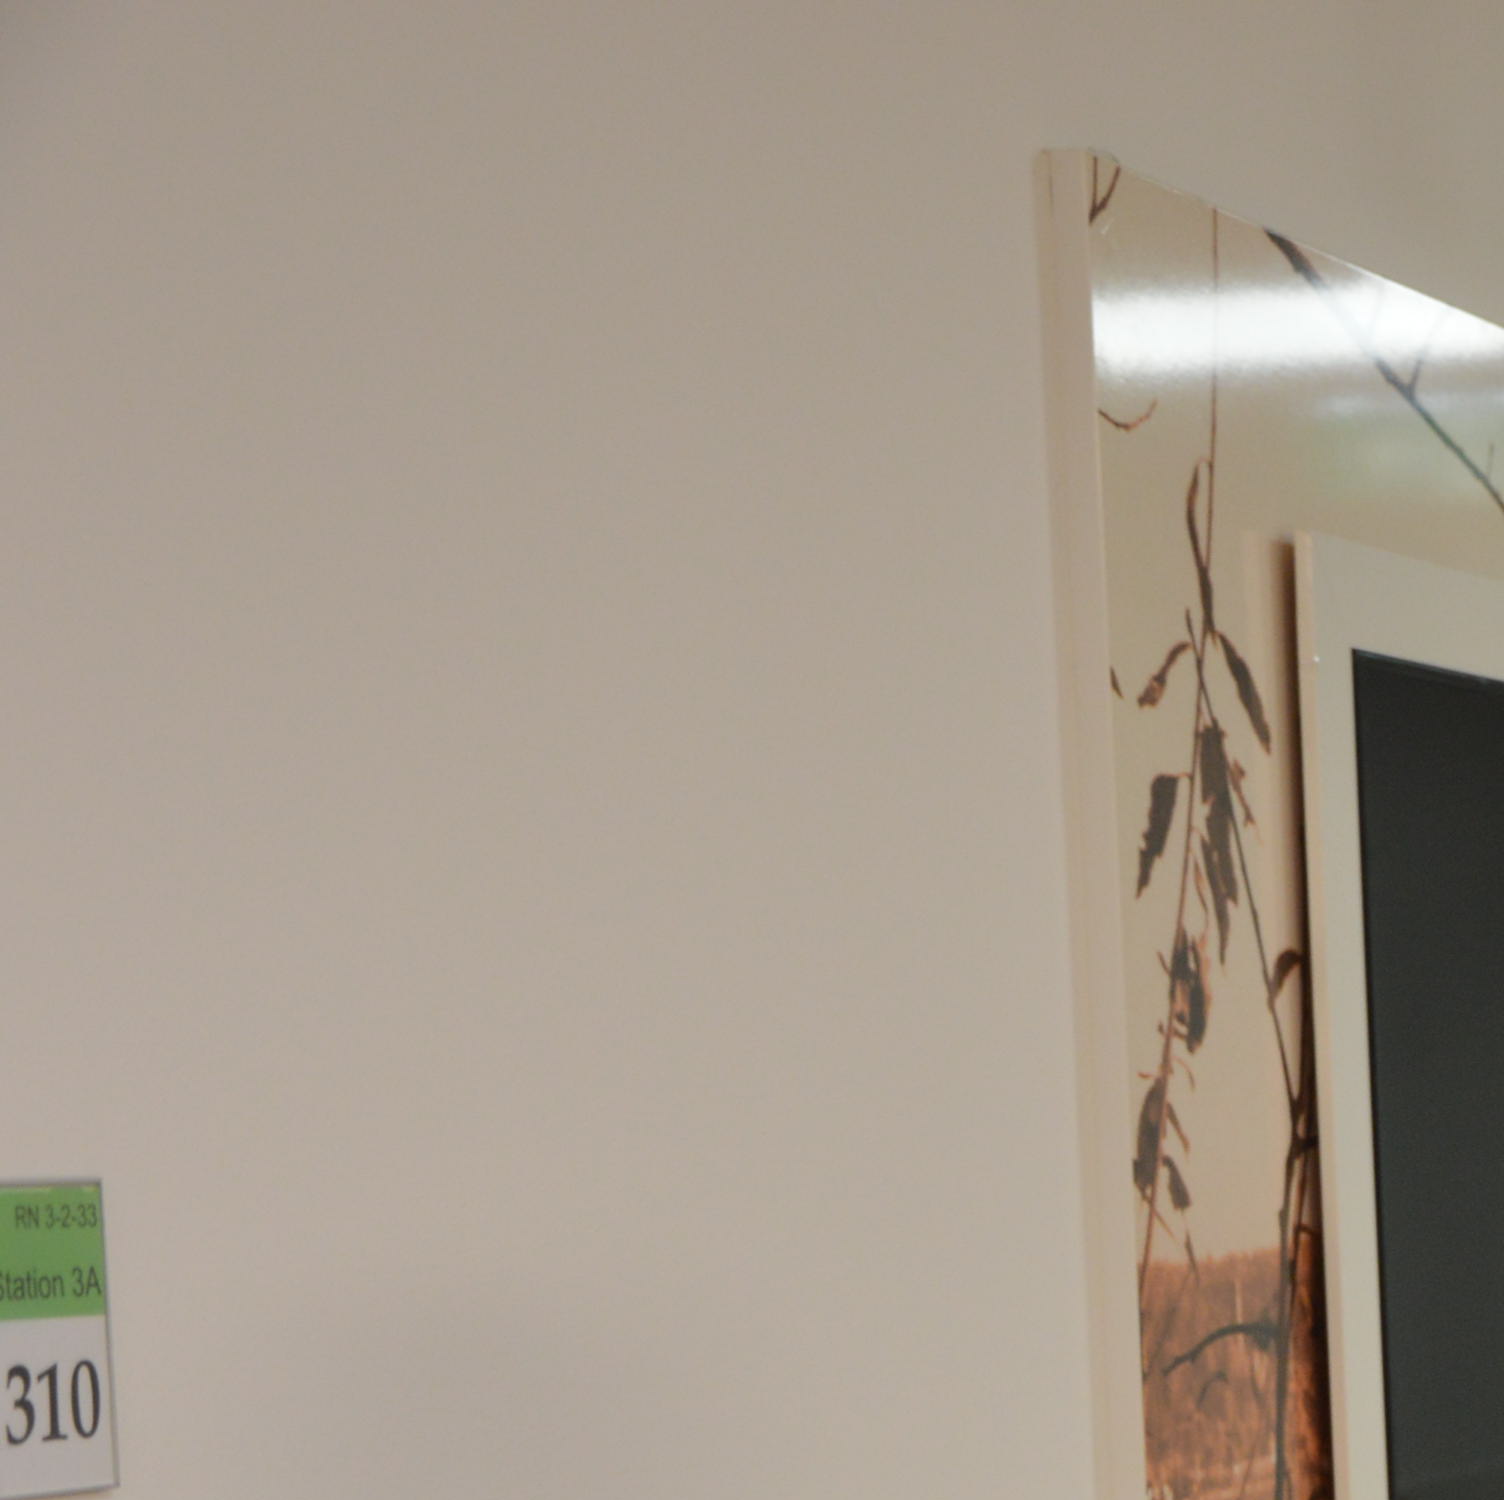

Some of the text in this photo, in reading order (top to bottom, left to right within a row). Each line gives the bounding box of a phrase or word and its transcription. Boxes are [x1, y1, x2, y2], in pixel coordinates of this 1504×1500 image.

[15, 1204, 98, 1230] RN 3-2-33
[72, 1266, 102, 1298] 3A
[6, 1360, 101, 1446] 310
